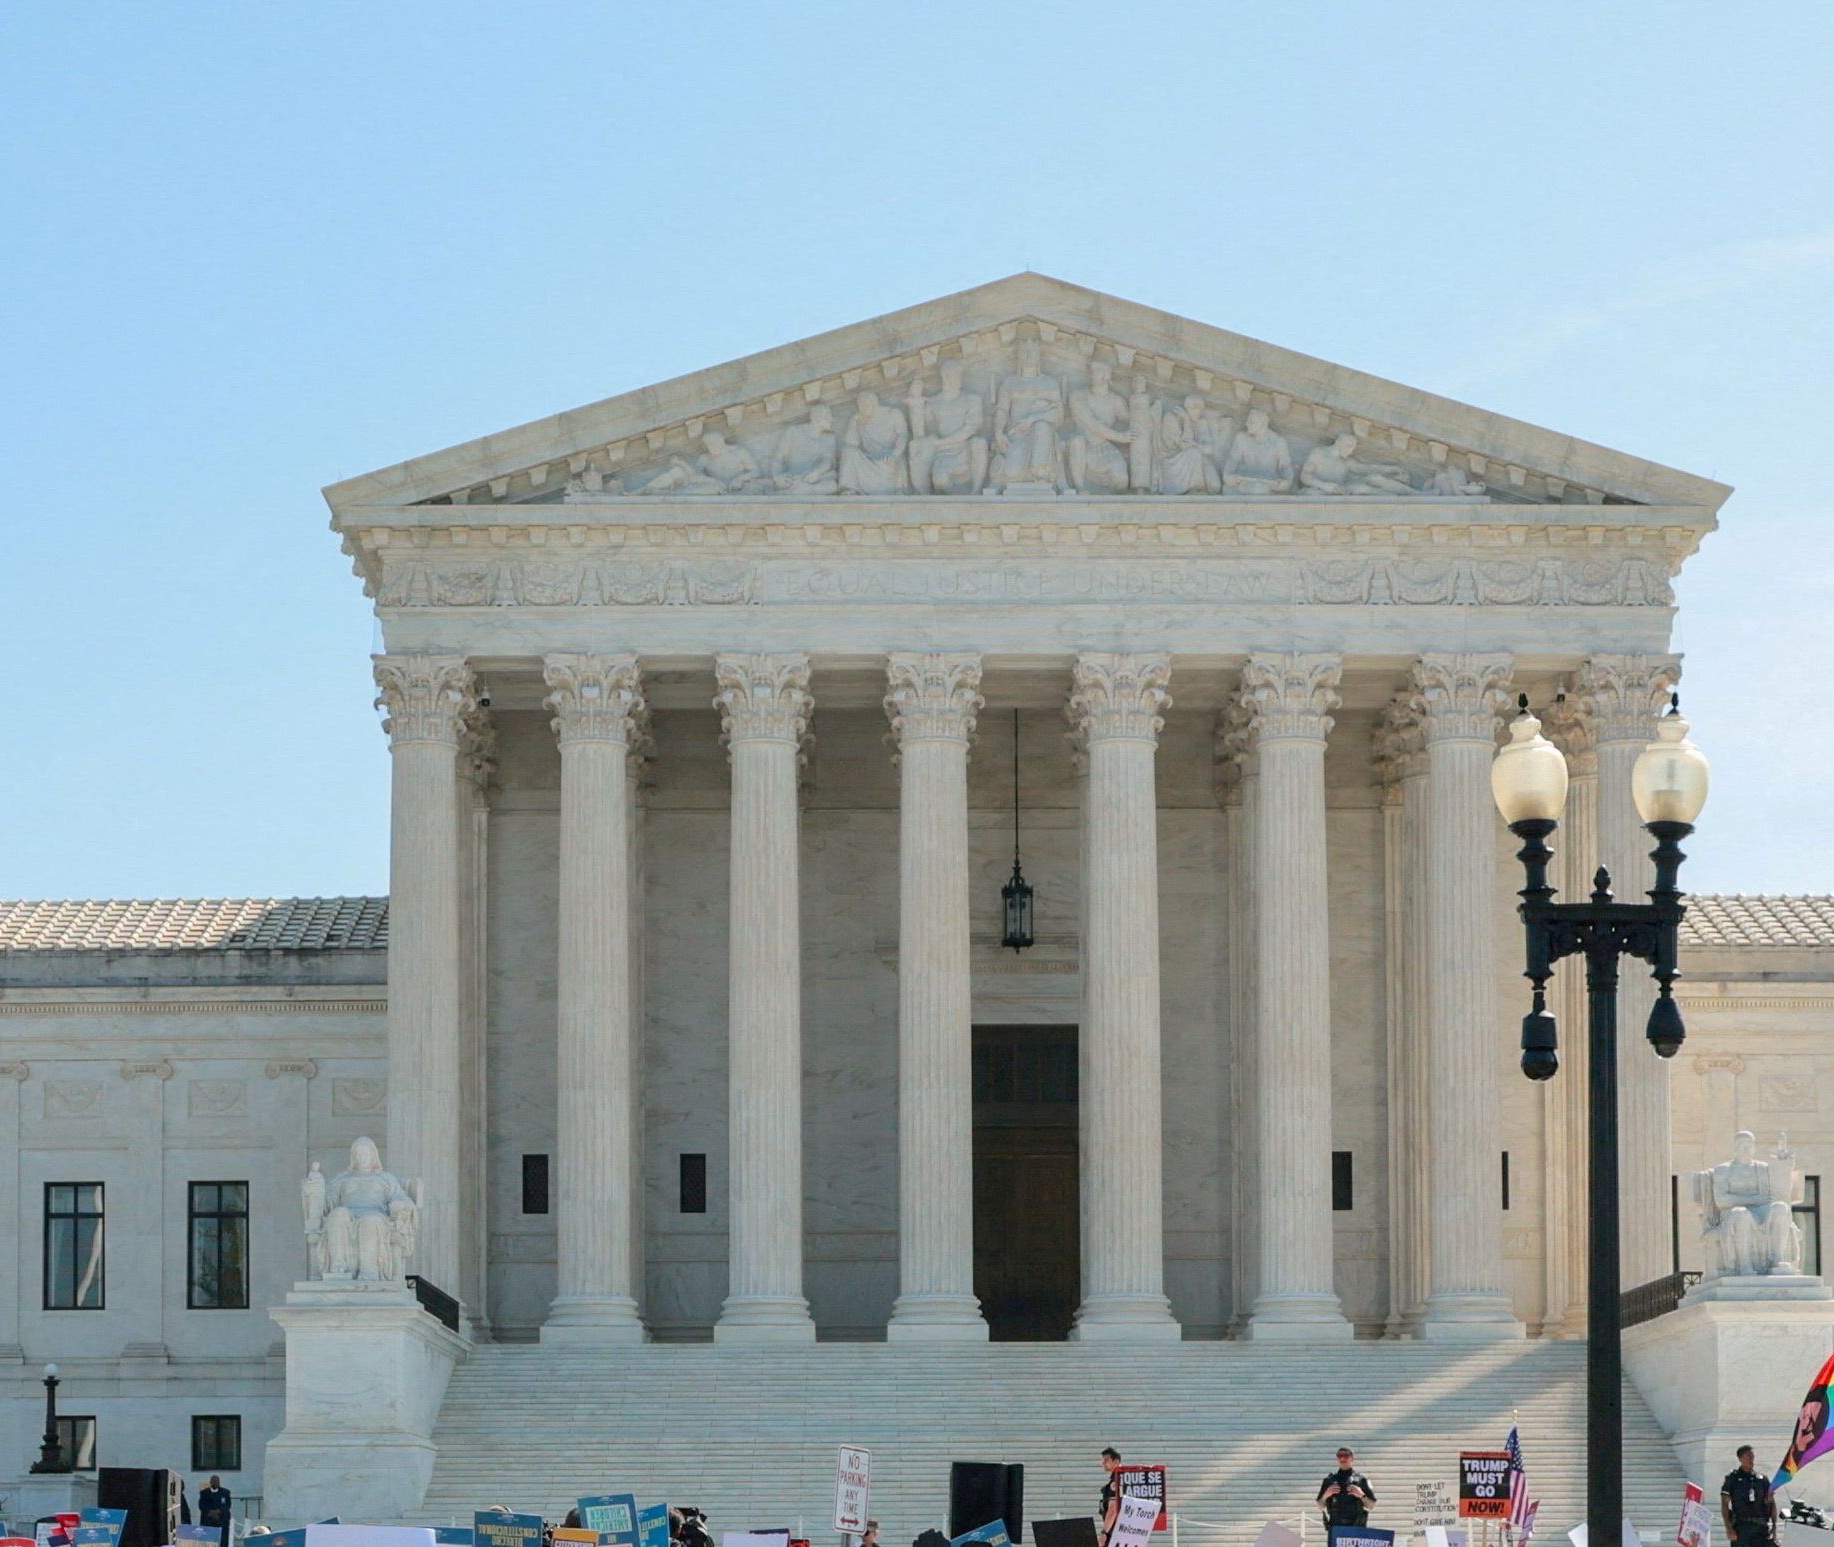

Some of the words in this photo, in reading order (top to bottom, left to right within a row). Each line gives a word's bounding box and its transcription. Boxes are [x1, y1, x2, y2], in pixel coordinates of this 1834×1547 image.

[786, 569, 907, 597] EQUAL
[920, 569, 1051, 597] JUSTICE
[1072, 569, 1192, 597] UNDER
[1203, 569, 1274, 597] LAW
[848, 1454, 860, 1470] NO
[1462, 1460, 1509, 1472] TRUMP
[840, 1471, 867, 1488] PARKING
[1120, 1472, 1146, 1485] ¡QUE
[1148, 1471, 1162, 1483] SE
[1467, 1473, 1505, 1484] MUST
[846, 1489, 859, 1501] ANY
[1475, 1485, 1495, 1497] GO
[843, 1502, 859, 1515] TIME
[1124, 1505, 1134, 1518] My
[1136, 1507, 1155, 1519] Torch
[1467, 1501, 1505, 1514] NOW!
